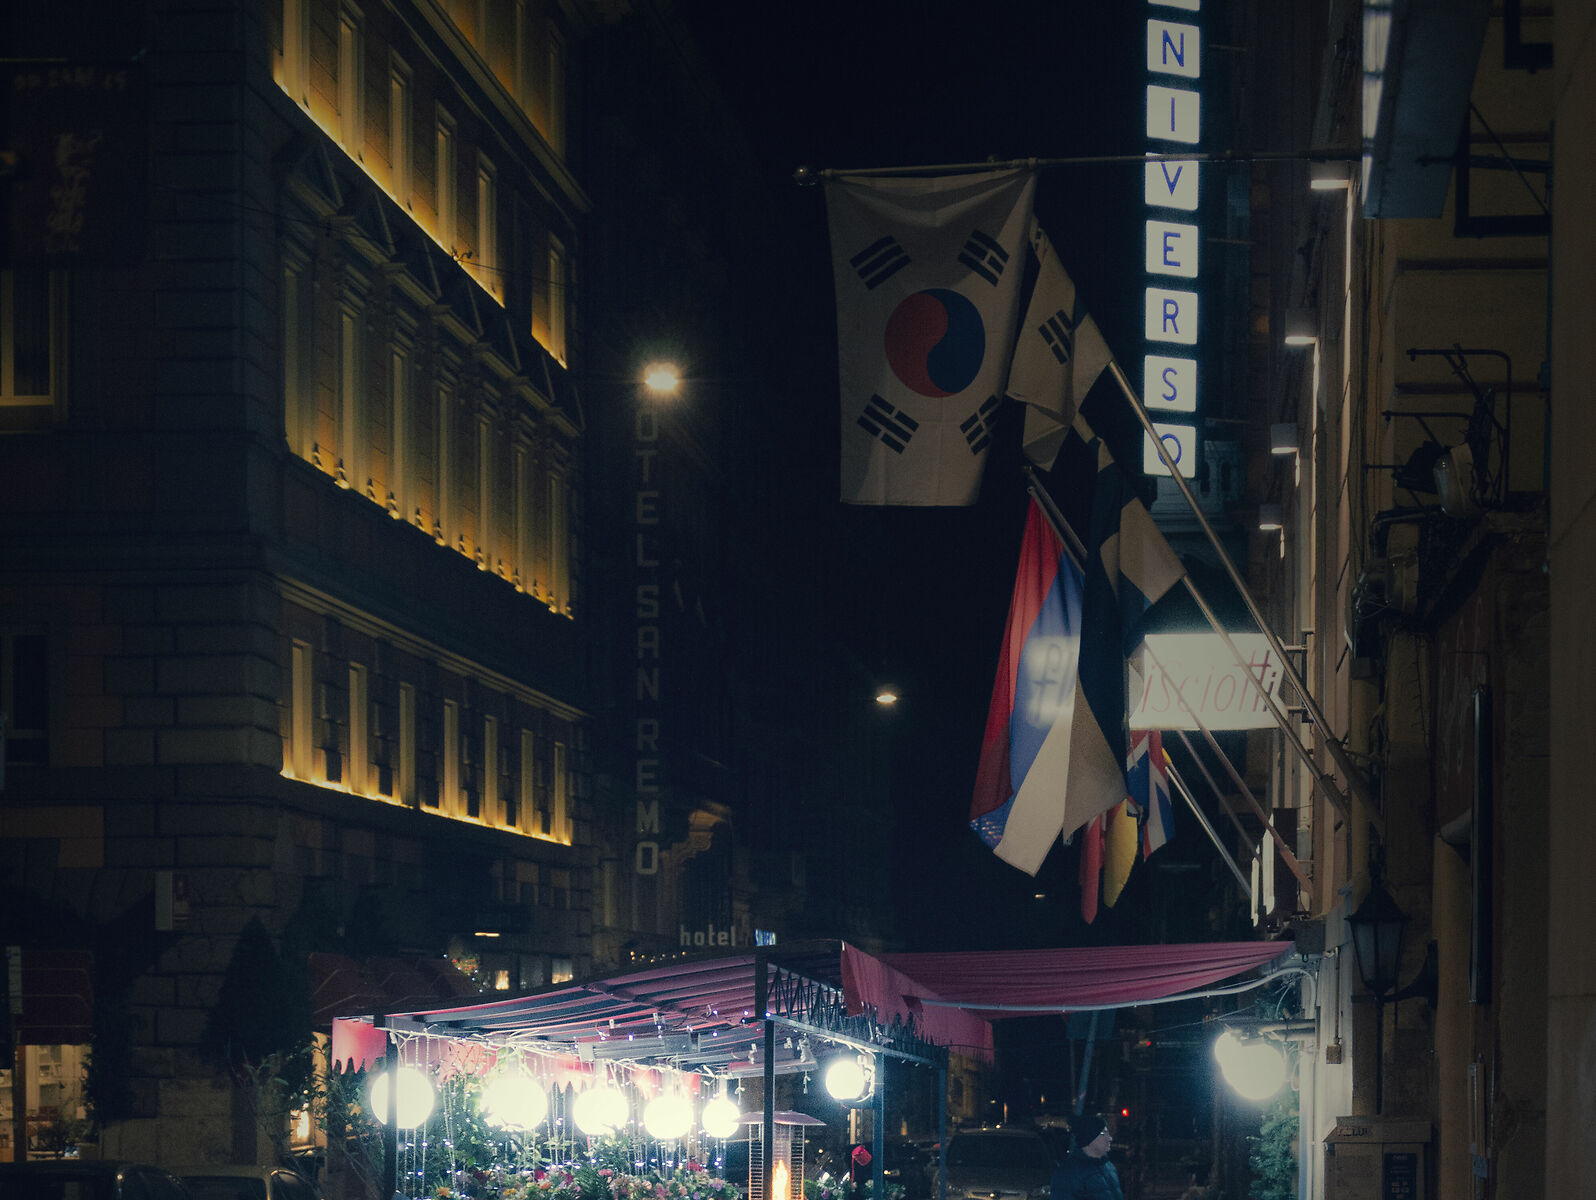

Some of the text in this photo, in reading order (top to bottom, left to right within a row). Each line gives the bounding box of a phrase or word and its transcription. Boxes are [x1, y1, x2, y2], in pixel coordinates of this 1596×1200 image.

[1157, 29, 1185, 465] NIVERSO
[635, 404, 659, 875] OTEL SAN REMO
[680, 924, 736, 946] hotel
